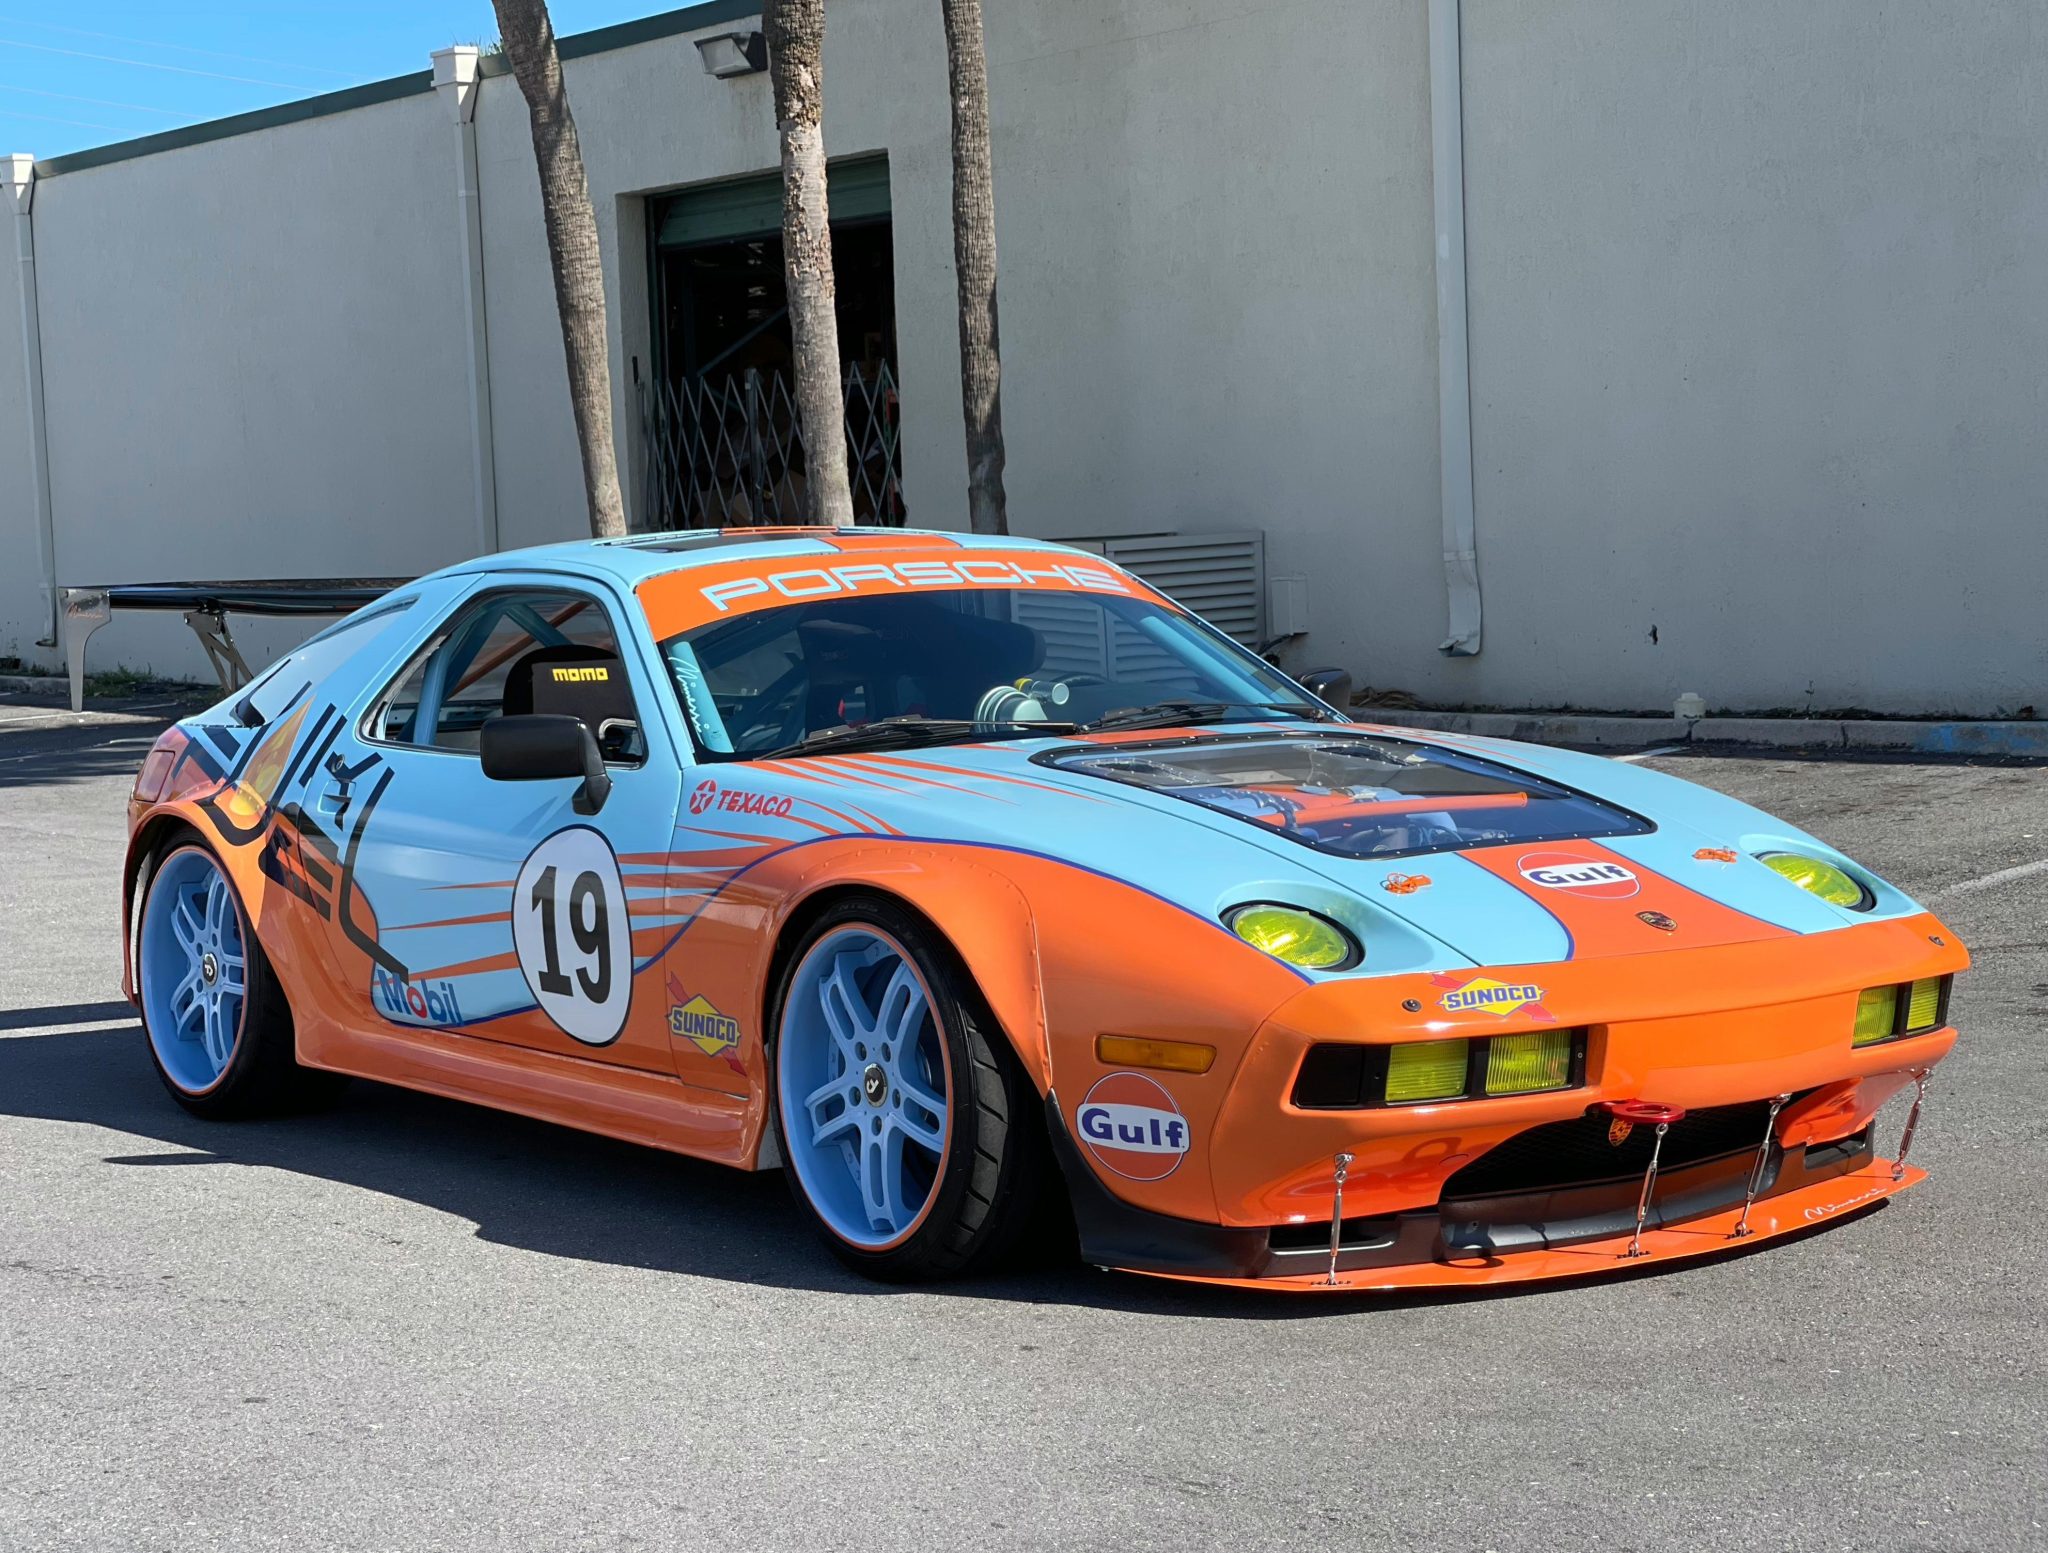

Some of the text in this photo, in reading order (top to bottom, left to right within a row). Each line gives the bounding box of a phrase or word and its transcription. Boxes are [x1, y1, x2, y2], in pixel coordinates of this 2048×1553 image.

[699, 560, 1131, 611] PORSCHE
[717, 789, 793, 818] TEXACO
[1529, 864, 1629, 885] Gulf
[531, 865, 612, 1004] 19
[377, 969, 464, 1028] Mobil
[1446, 986, 1538, 1009] SUNOCO
[672, 1009, 736, 1043] SUNOCO
[1081, 1107, 1184, 1148] Gulf
